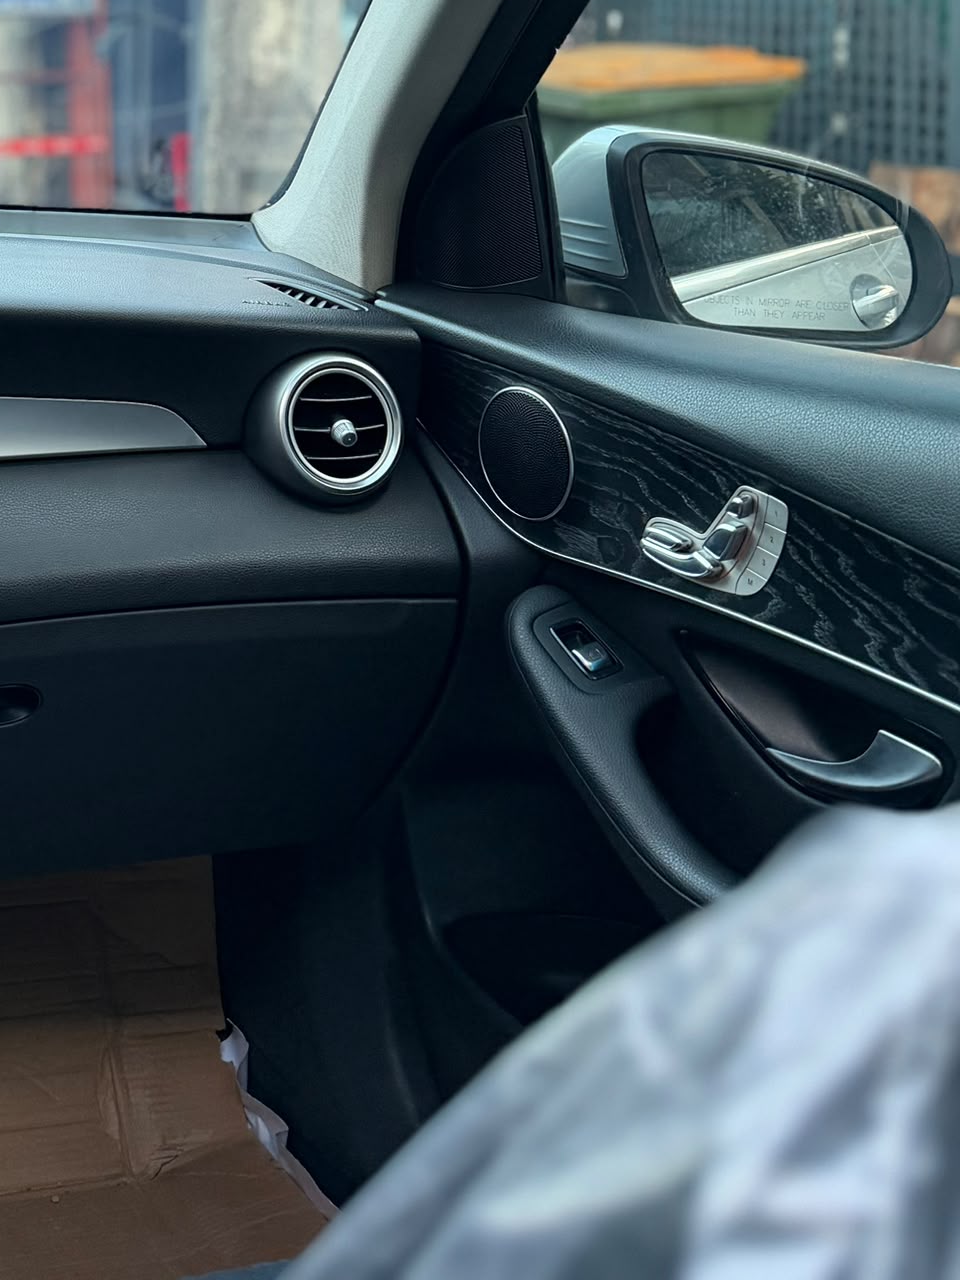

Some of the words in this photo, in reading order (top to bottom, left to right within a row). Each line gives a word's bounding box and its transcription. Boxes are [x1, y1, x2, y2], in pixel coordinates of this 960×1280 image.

[704, 295, 740, 306] OBJECTS
[745, 296, 753, 306] IN
[758, 297, 790, 308] MIRROR
[795, 299, 812, 310] ARE
[816, 300, 849, 312] CLOSER
[733, 307, 756, 317] THAN
[764, 308, 785, 319] THEY
[792, 310, 826, 321] APPEAR
